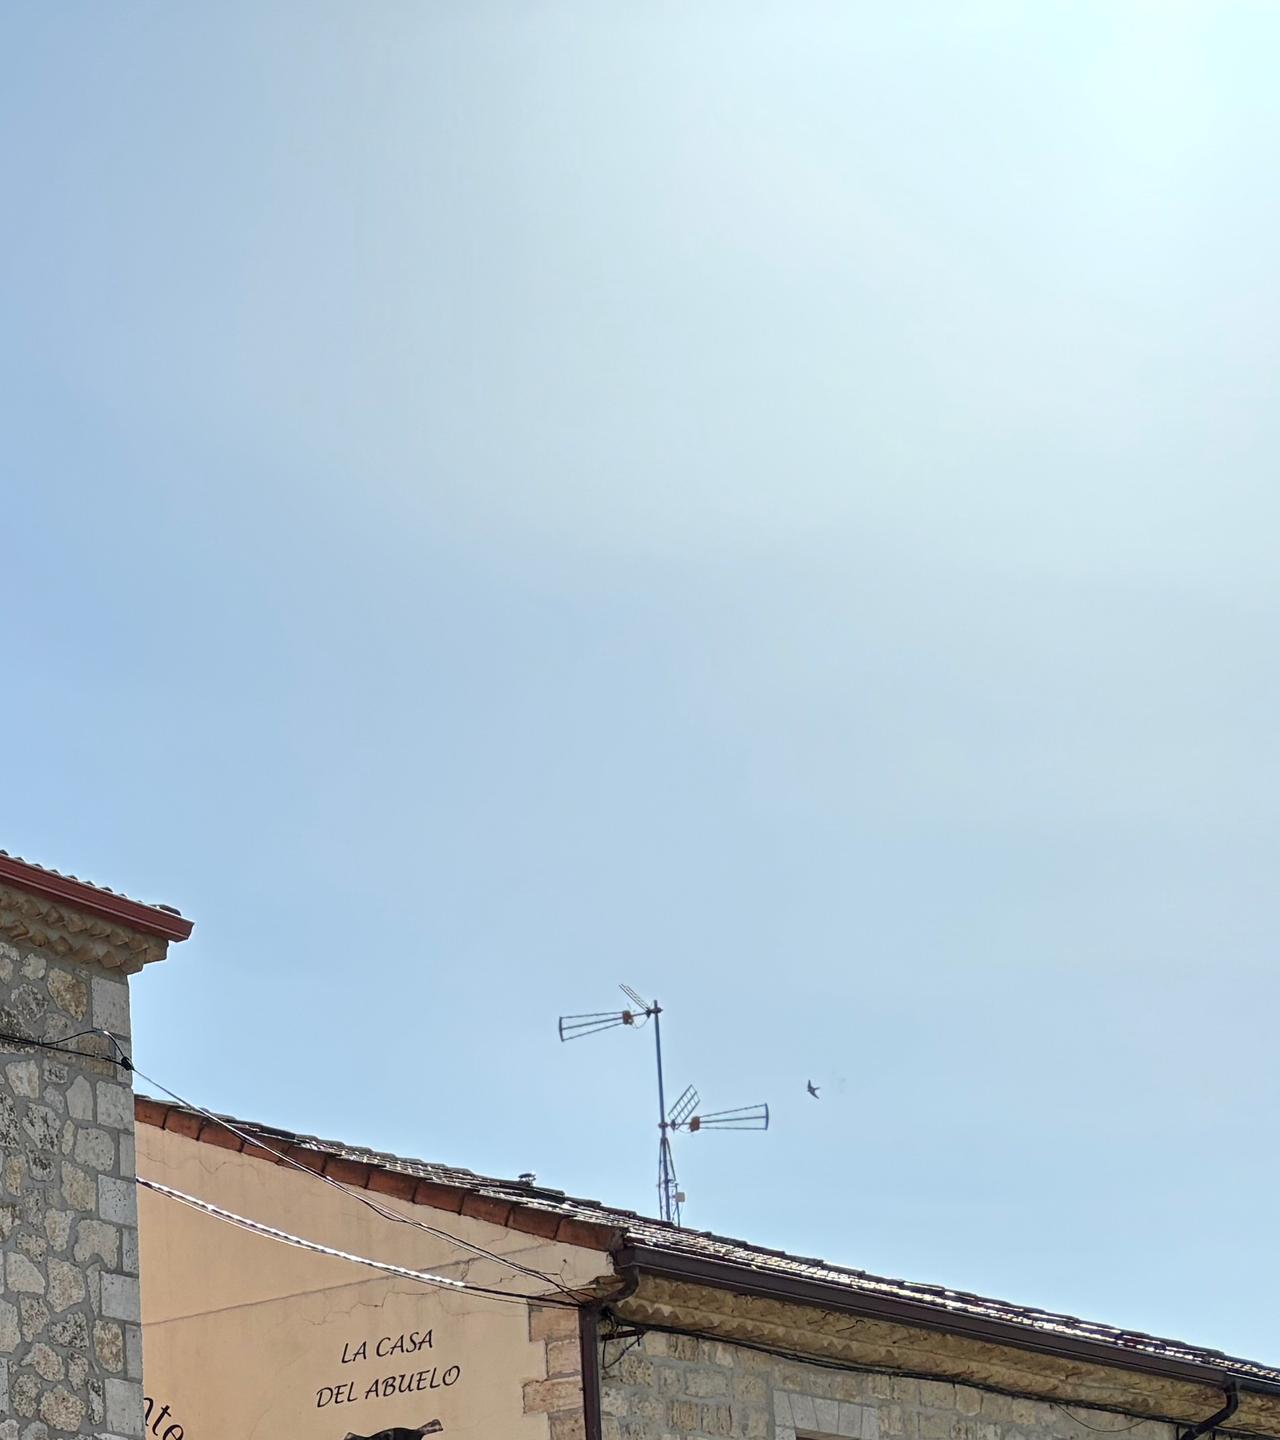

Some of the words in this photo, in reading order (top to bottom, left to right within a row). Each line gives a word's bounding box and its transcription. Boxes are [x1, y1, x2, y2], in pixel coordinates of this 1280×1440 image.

[341, 1340, 367, 1364] LA
[375, 1328, 433, 1358] CASA
[316, 1381, 358, 1408] DEL
[364, 1365, 461, 1400] ABUELO
